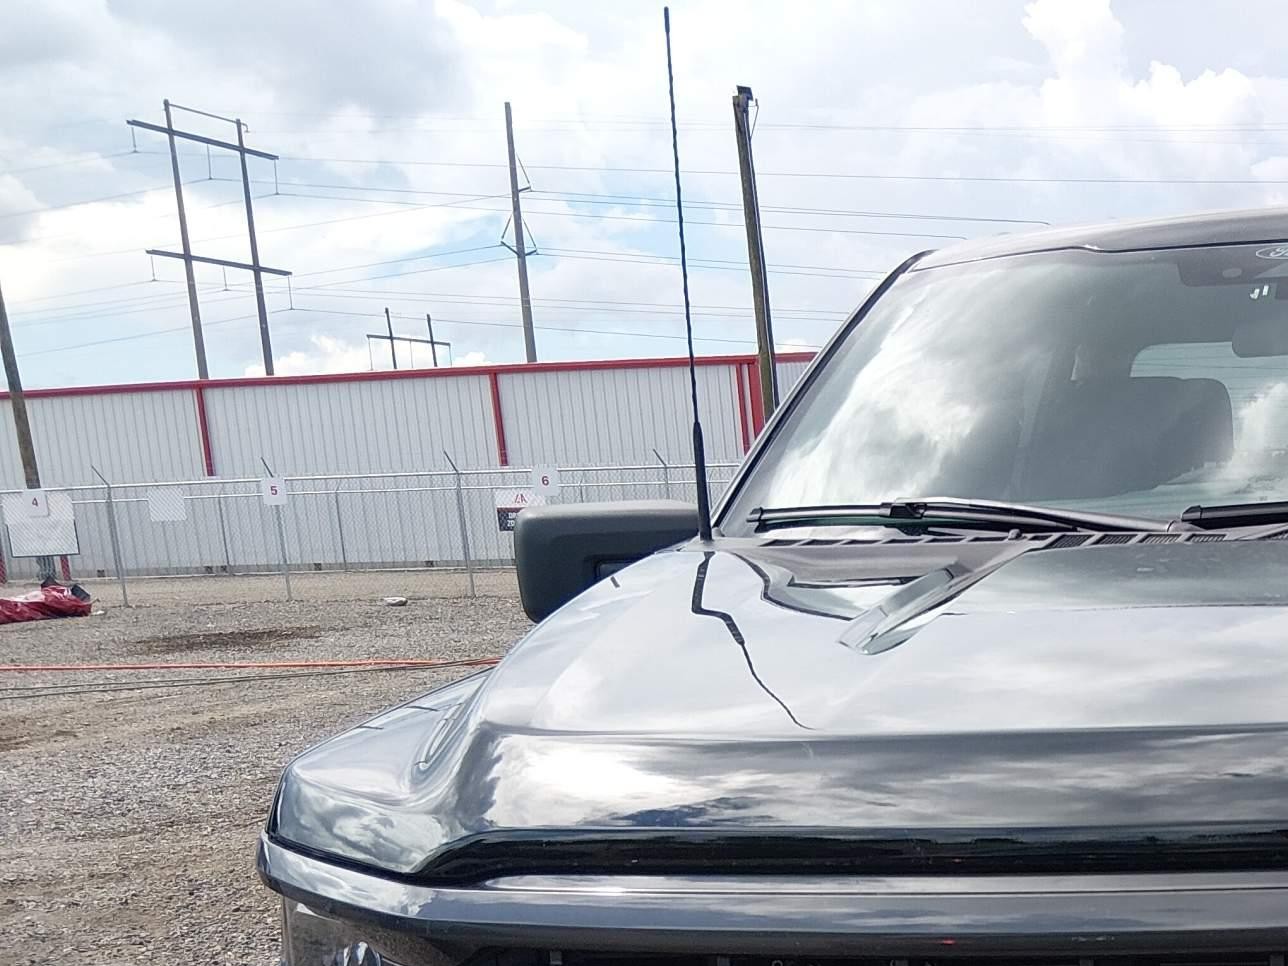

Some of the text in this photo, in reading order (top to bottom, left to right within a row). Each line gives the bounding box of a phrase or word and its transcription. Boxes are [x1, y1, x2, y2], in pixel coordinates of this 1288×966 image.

[541, 475, 550, 486] 6
[270, 485, 278, 496] 5
[31, 497, 39, 507] 4
